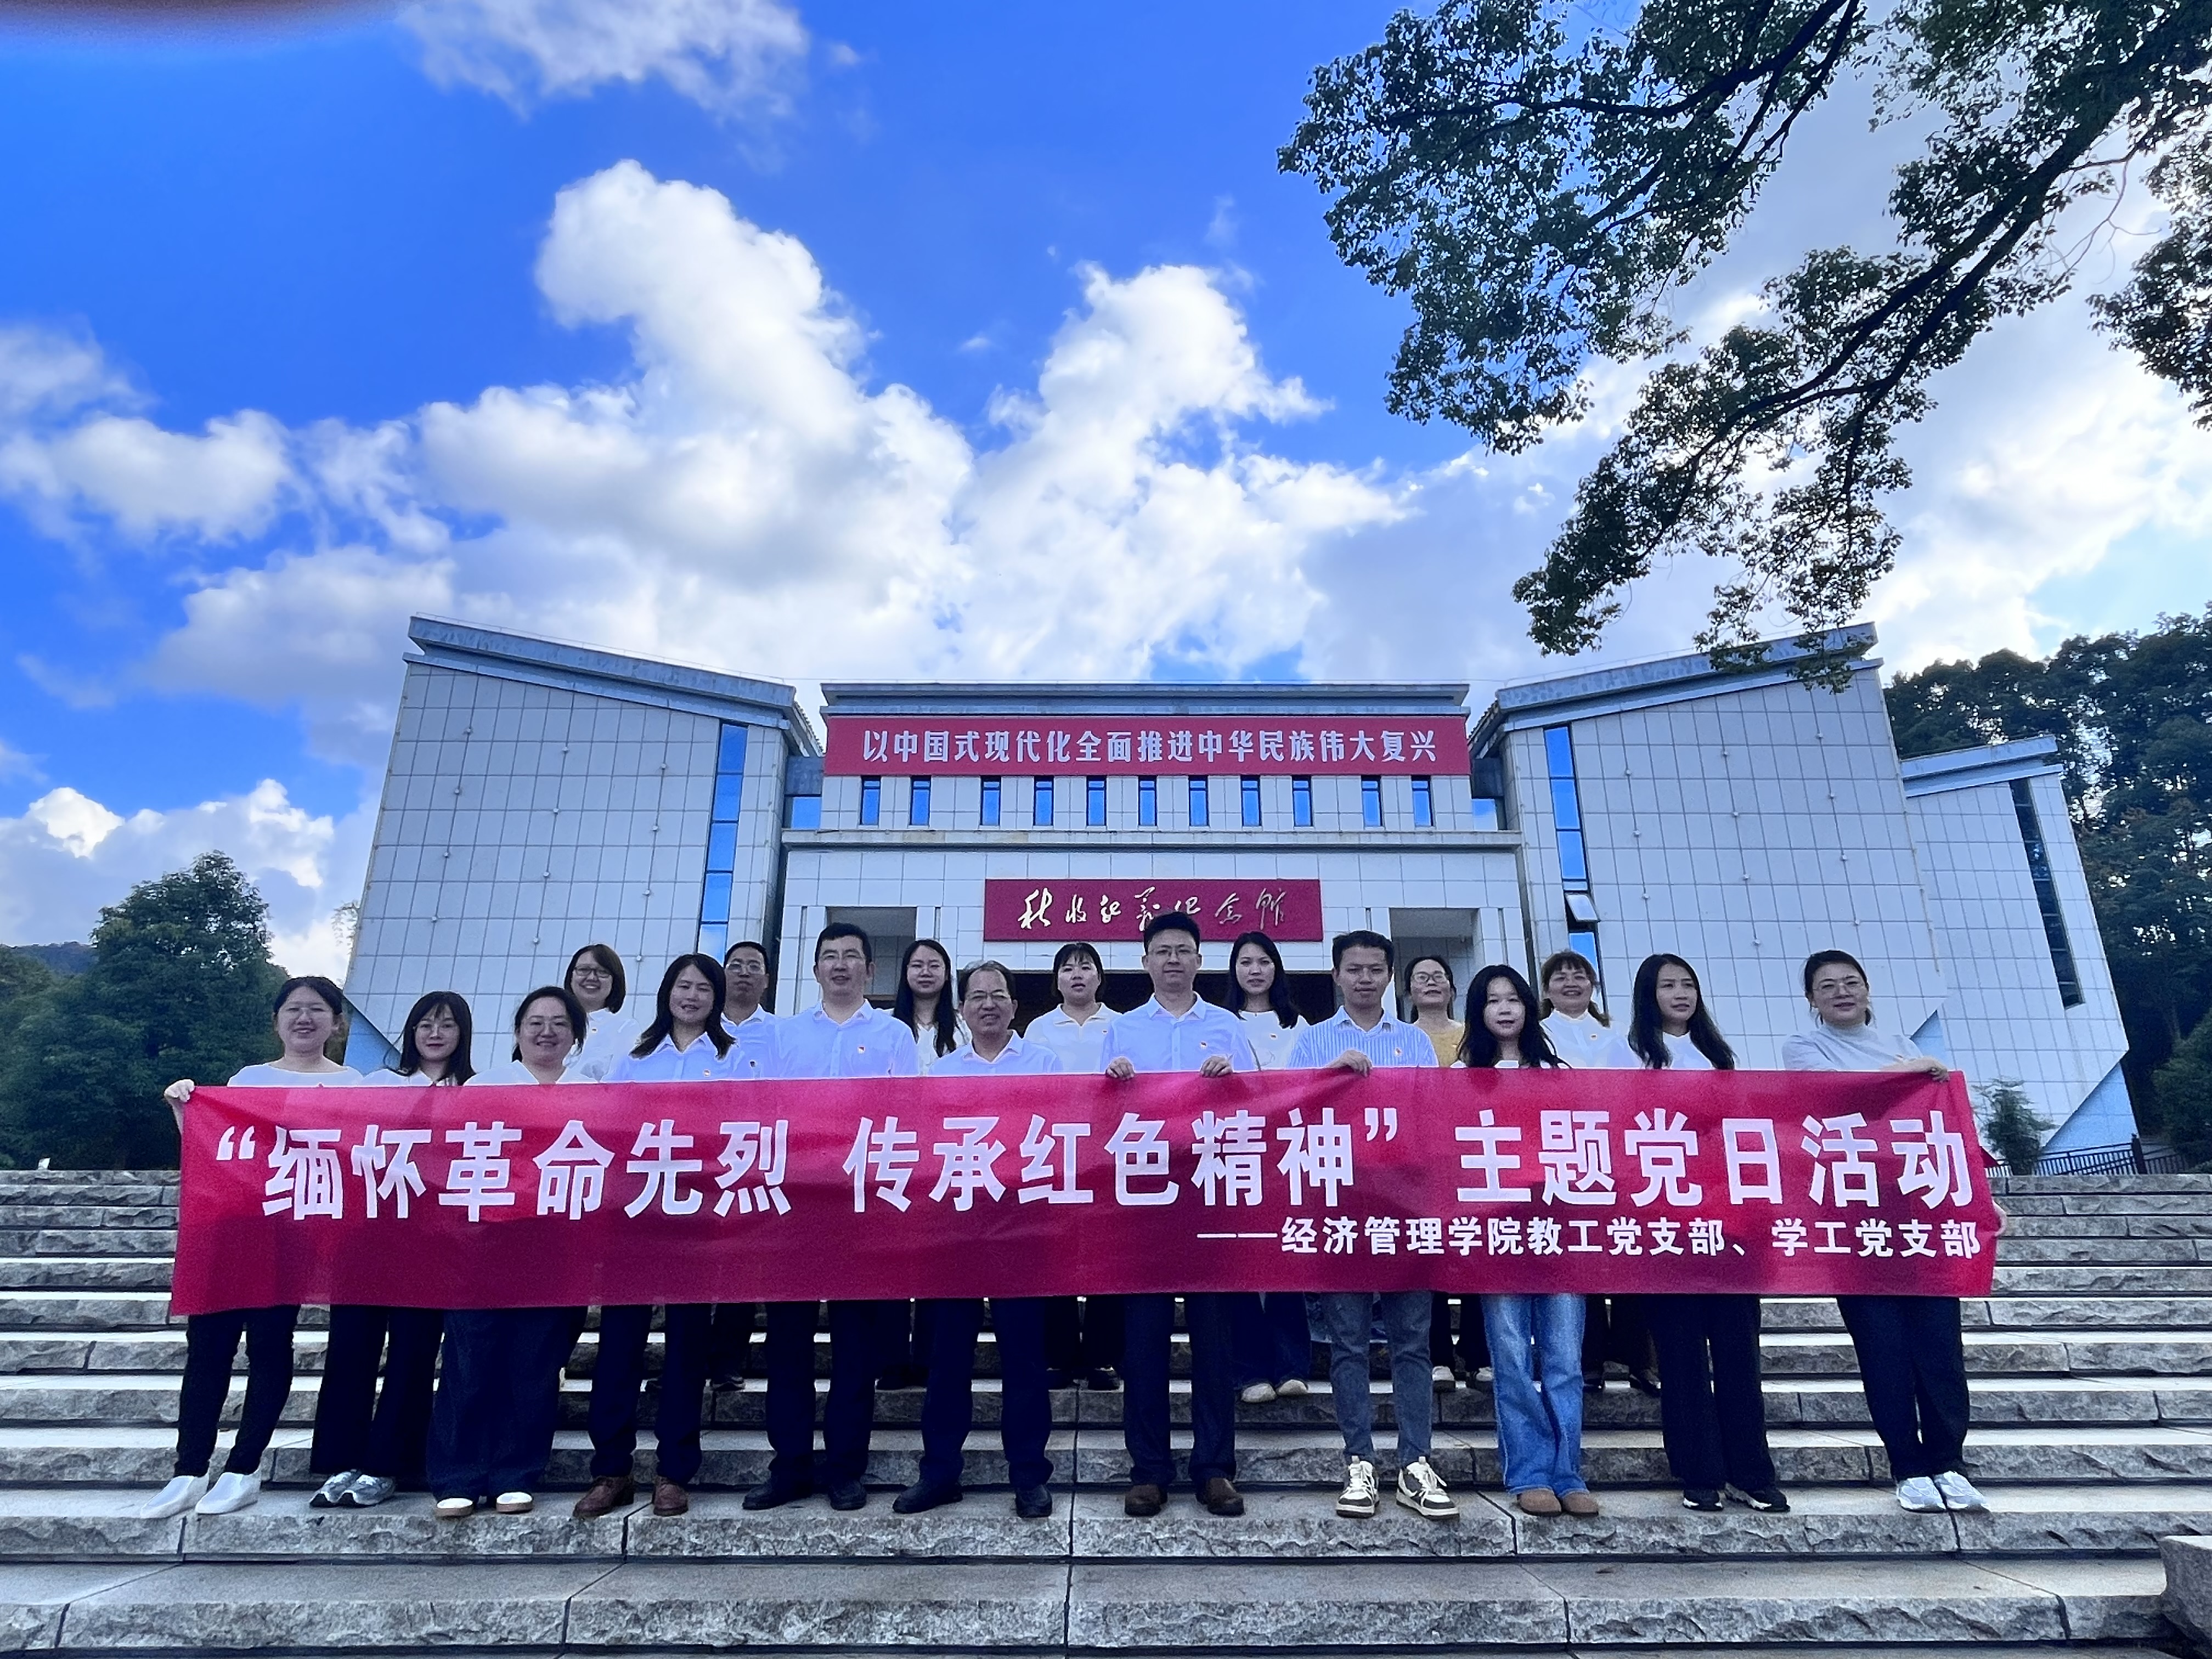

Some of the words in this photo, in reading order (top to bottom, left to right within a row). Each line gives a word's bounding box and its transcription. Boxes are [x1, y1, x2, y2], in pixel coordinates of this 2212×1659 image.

[863, 730, 1436, 763] 以中国式现代化全面推进中华民族伟大复兴
[216, 1119, 791, 1222] “缅怀革命先烈
[842, 1107, 1397, 1212] 传承红色精神”
[1454, 1108, 1973, 1209] 主题党日活动
